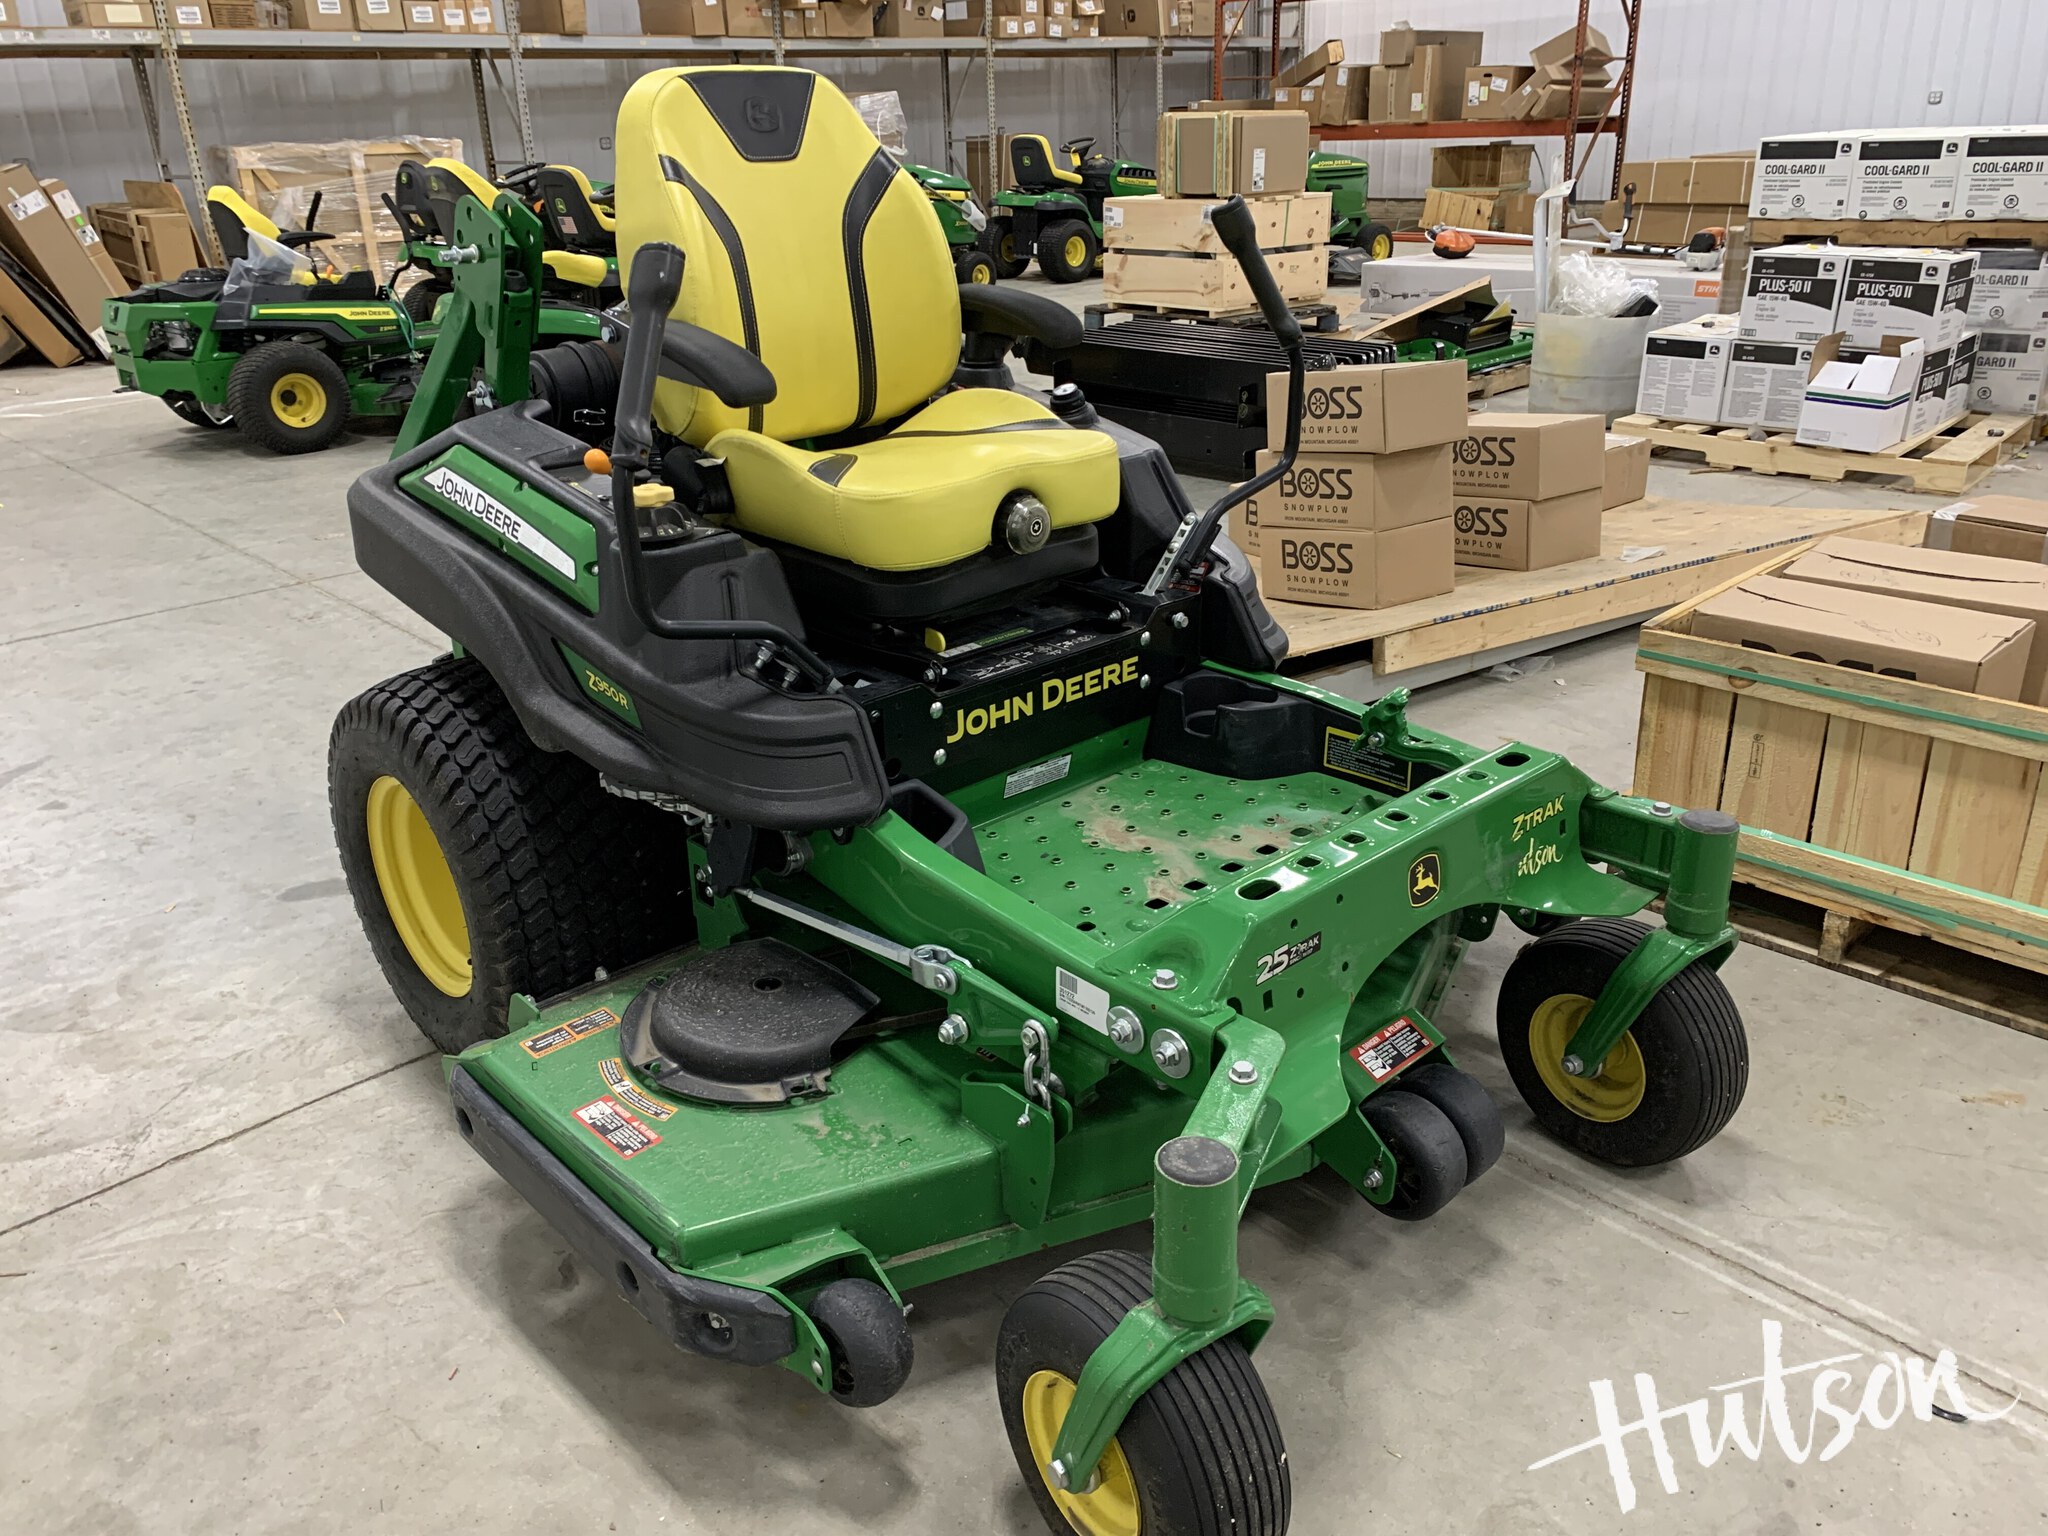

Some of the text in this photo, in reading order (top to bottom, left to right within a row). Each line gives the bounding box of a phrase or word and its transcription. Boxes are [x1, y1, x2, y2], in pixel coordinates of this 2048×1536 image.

[1765, 164, 1826, 174] COOL-GARD II
[1864, 165, 1929, 176] COOL-GARD II
[1972, 162, 2044, 173] COOL-GARD II
[1759, 279, 1812, 293] PLUS-50 II
[1975, 275, 2028, 286] OL-GARD II
[1857, 283, 1912, 298] PLUS-50 II
[1301, 426, 1358, 434] NOWPLOW
[1453, 470, 1509, 479] NOWPLOW
[1280, 468, 1352, 500] BOSS
[437, 472, 521, 540] JOHN DEERE
[1284, 503, 1348, 514] SNOWPLOW
[1454, 505, 1509, 537] OSS
[1455, 538, 1502, 550] OWPLOW
[1281, 539, 1353, 574] BOSS
[1287, 575, 1349, 587] SNOWPLOW
[585, 669, 629, 710] Z950R
[947, 691, 1033, 744] JOHN
[1042, 656, 1139, 710] DEERE
[1512, 794, 1565, 841] ZTRAK
[1257, 944, 1289, 985] 25
